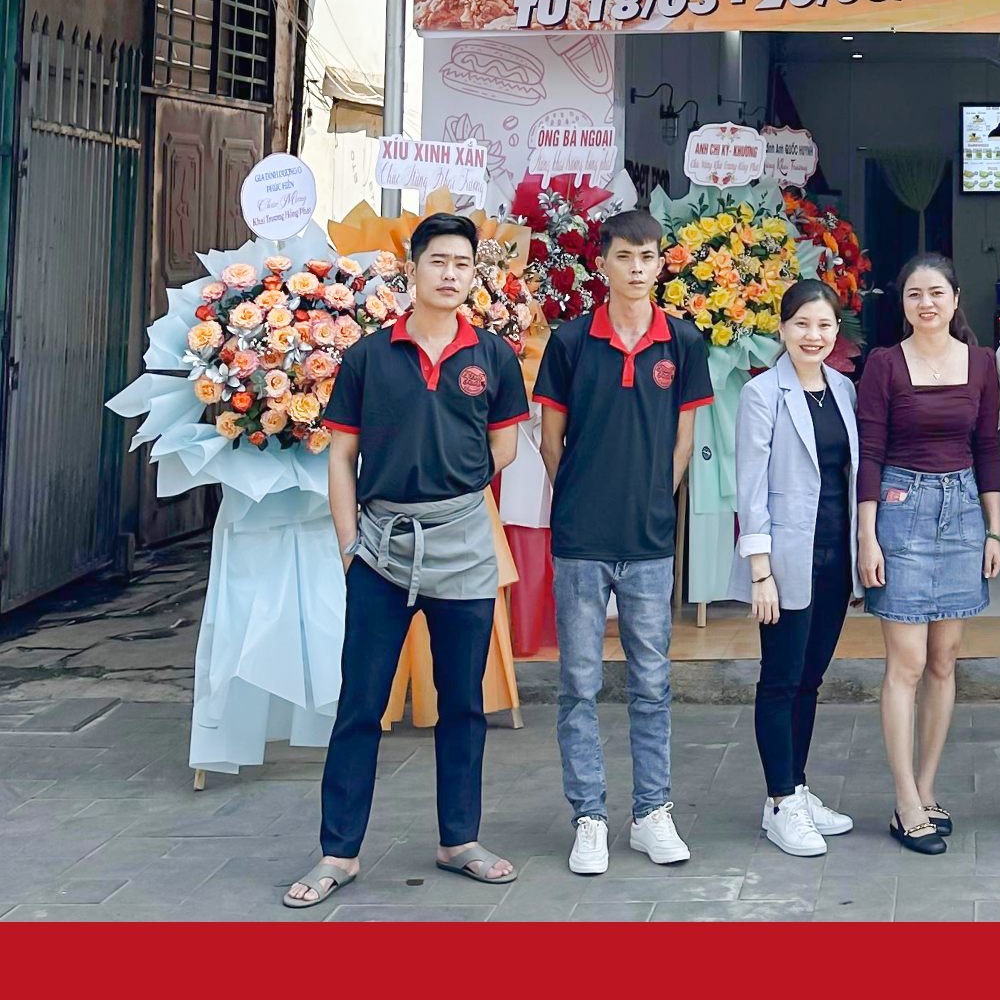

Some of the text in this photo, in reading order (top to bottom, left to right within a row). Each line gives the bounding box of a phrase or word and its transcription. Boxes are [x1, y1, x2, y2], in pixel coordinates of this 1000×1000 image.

[382, 137, 409, 161] XÍU
[414, 142, 451, 165] XINH
[537, 125, 613, 151] ÔNG BÀ NGOẠI
